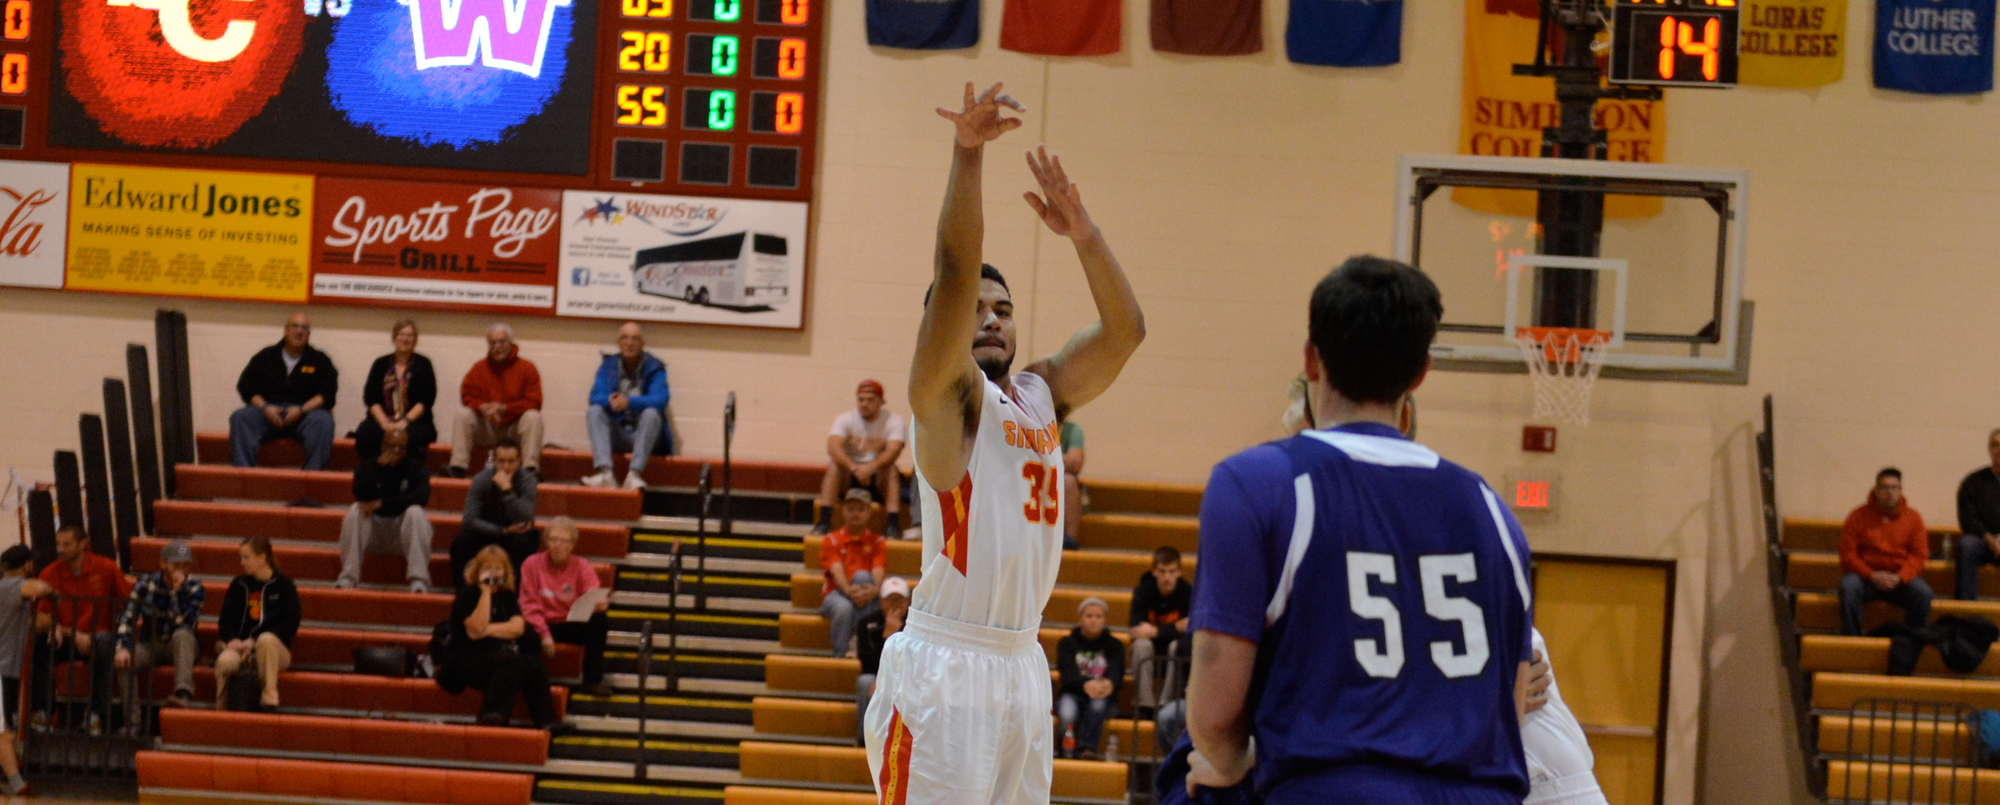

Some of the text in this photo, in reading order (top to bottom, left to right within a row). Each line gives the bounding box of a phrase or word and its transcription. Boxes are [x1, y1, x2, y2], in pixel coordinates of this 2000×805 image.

[4, 0, 31, 40] 0
[1751, 3, 1827, 31] LORAS
[1892, 6, 1978, 32] LUTHER
[619, 30, 671, 72] 20
[711, 35, 739, 76] 0
[778, 38, 806, 79] 0
[1659, 15, 1720, 81] 14
[1887, 30, 1981, 57] COLLEGE
[1, 52, 28, 94] 0
[617, 85, 667, 127] 55
[708, 90, 736, 131] 0
[775, 92, 804, 134] 0
[1474, 96, 1653, 131] SIMON
[82, 175, 301, 218] Edward Jones
[81, 222, 299, 246] MAKING SENSE OF INVESTING
[324, 187, 559, 264] Sports Page
[400, 246, 482, 274] GRILL
[1516, 480, 1550, 508] EXIT
[1346, 551, 1491, 679] 55
